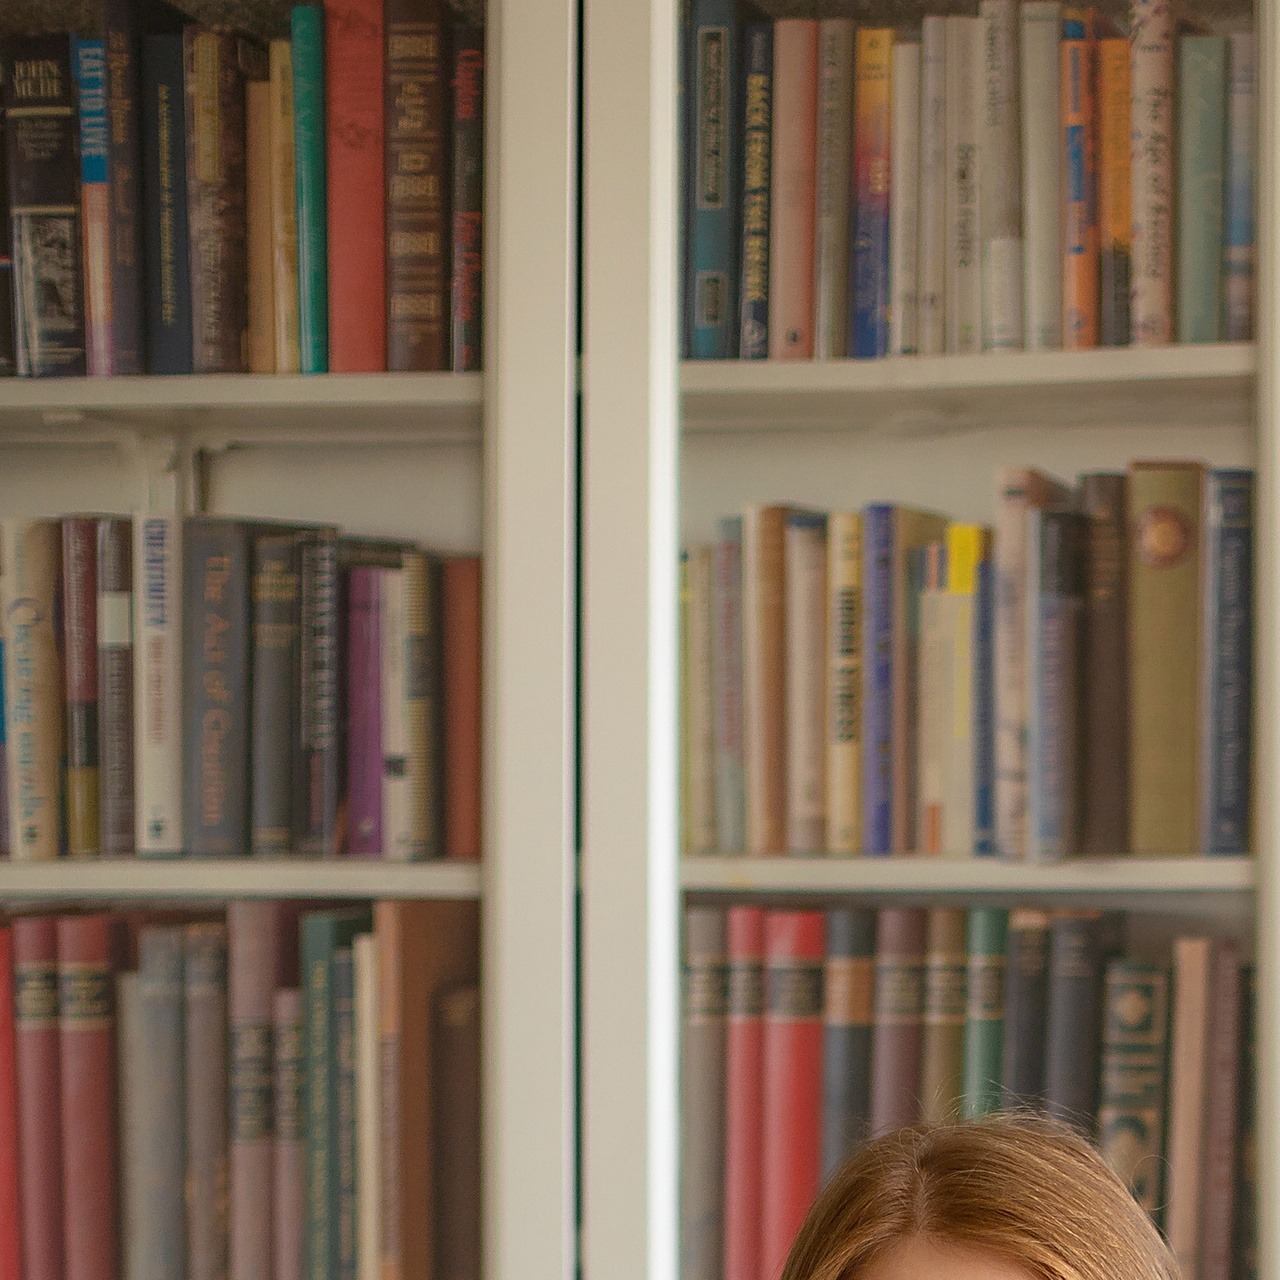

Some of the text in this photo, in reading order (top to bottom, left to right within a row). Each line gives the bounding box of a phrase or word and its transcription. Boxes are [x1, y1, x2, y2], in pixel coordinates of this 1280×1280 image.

[79, 47, 106, 158] EAT TO LIVE
[745, 74, 769, 128] BACK
[745, 131, 769, 191] FROM
[745, 194, 768, 233] THE
[203, 554, 231, 603] The
[202, 670, 230, 702] of
